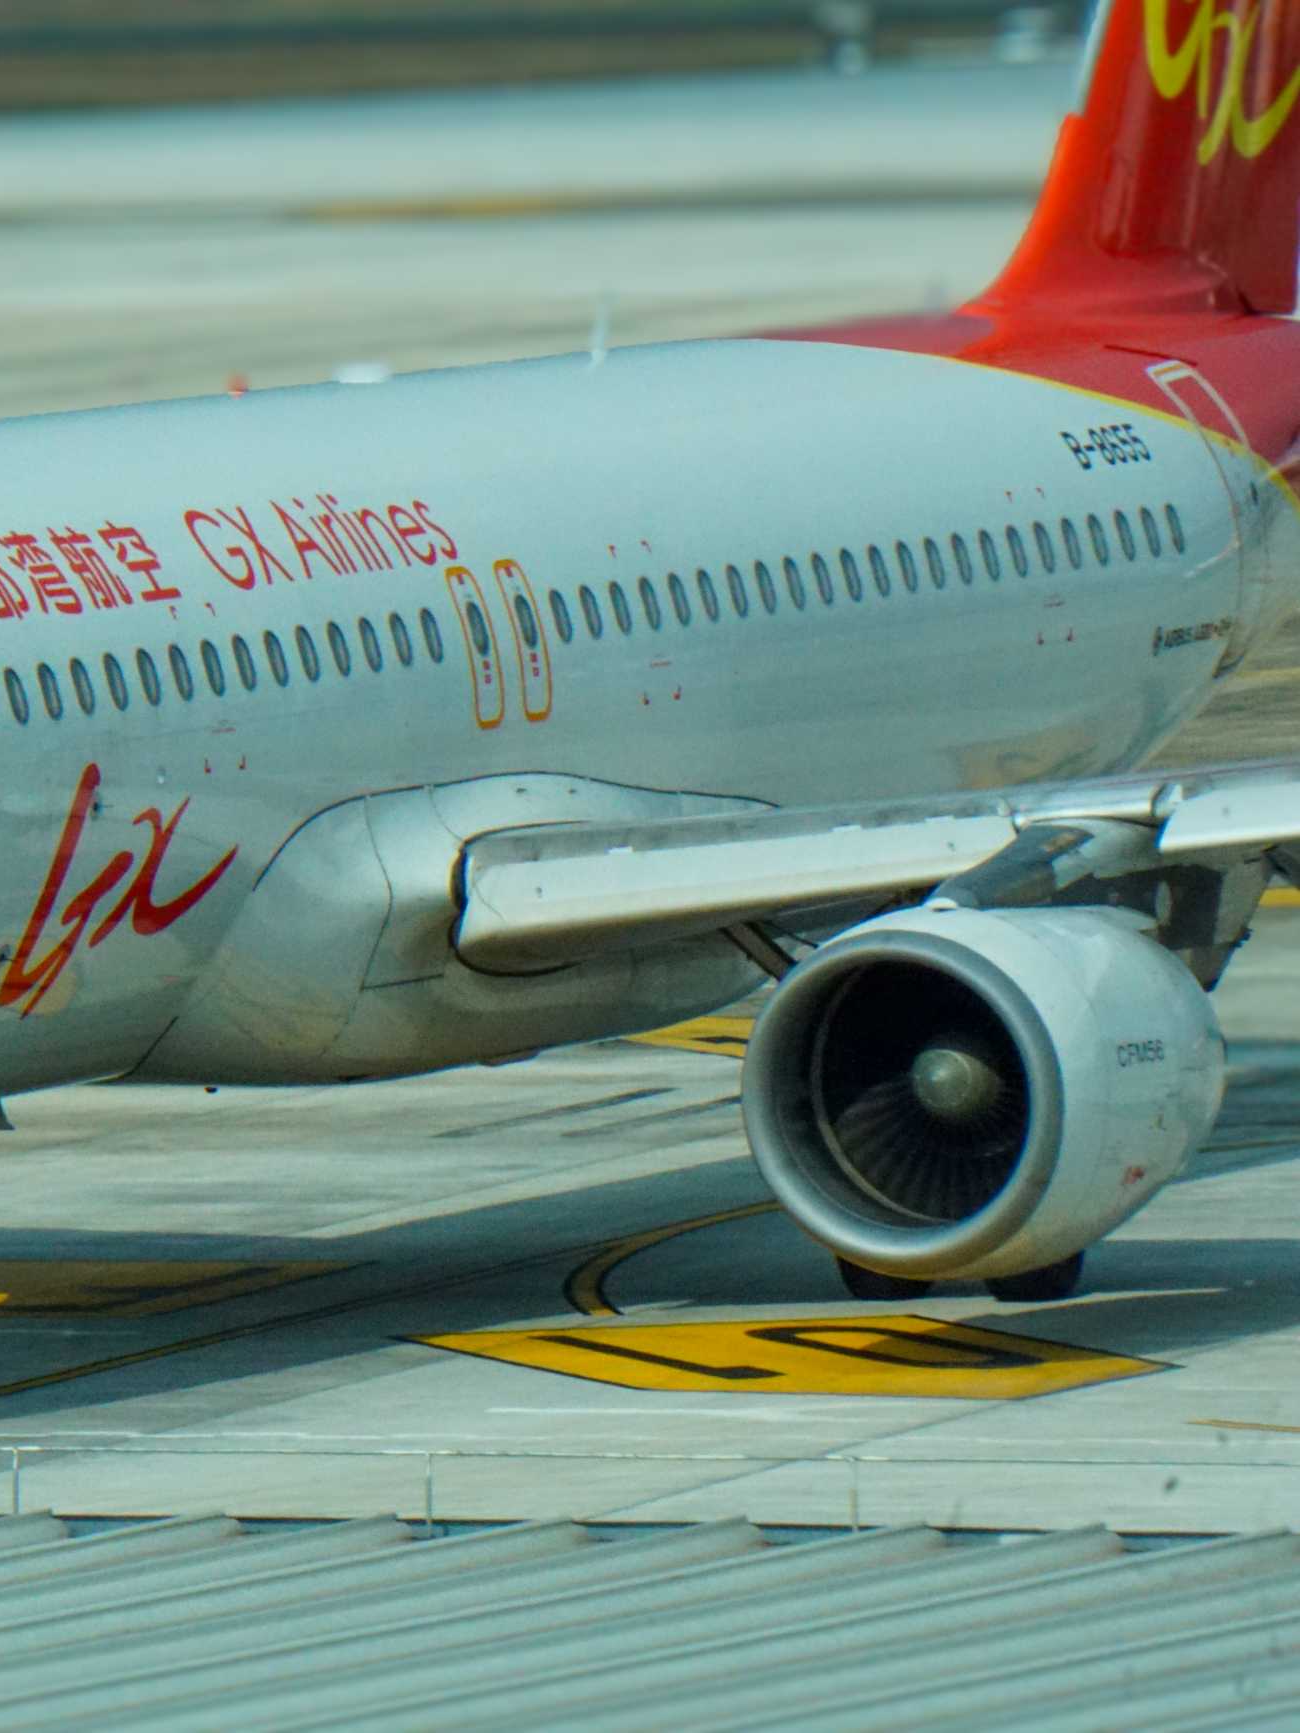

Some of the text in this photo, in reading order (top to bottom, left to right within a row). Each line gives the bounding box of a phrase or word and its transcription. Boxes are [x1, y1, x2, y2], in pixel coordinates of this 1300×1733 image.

[1059, 423, 1151, 470] B-8655
[184, 493, 458, 591] GX Airlines
